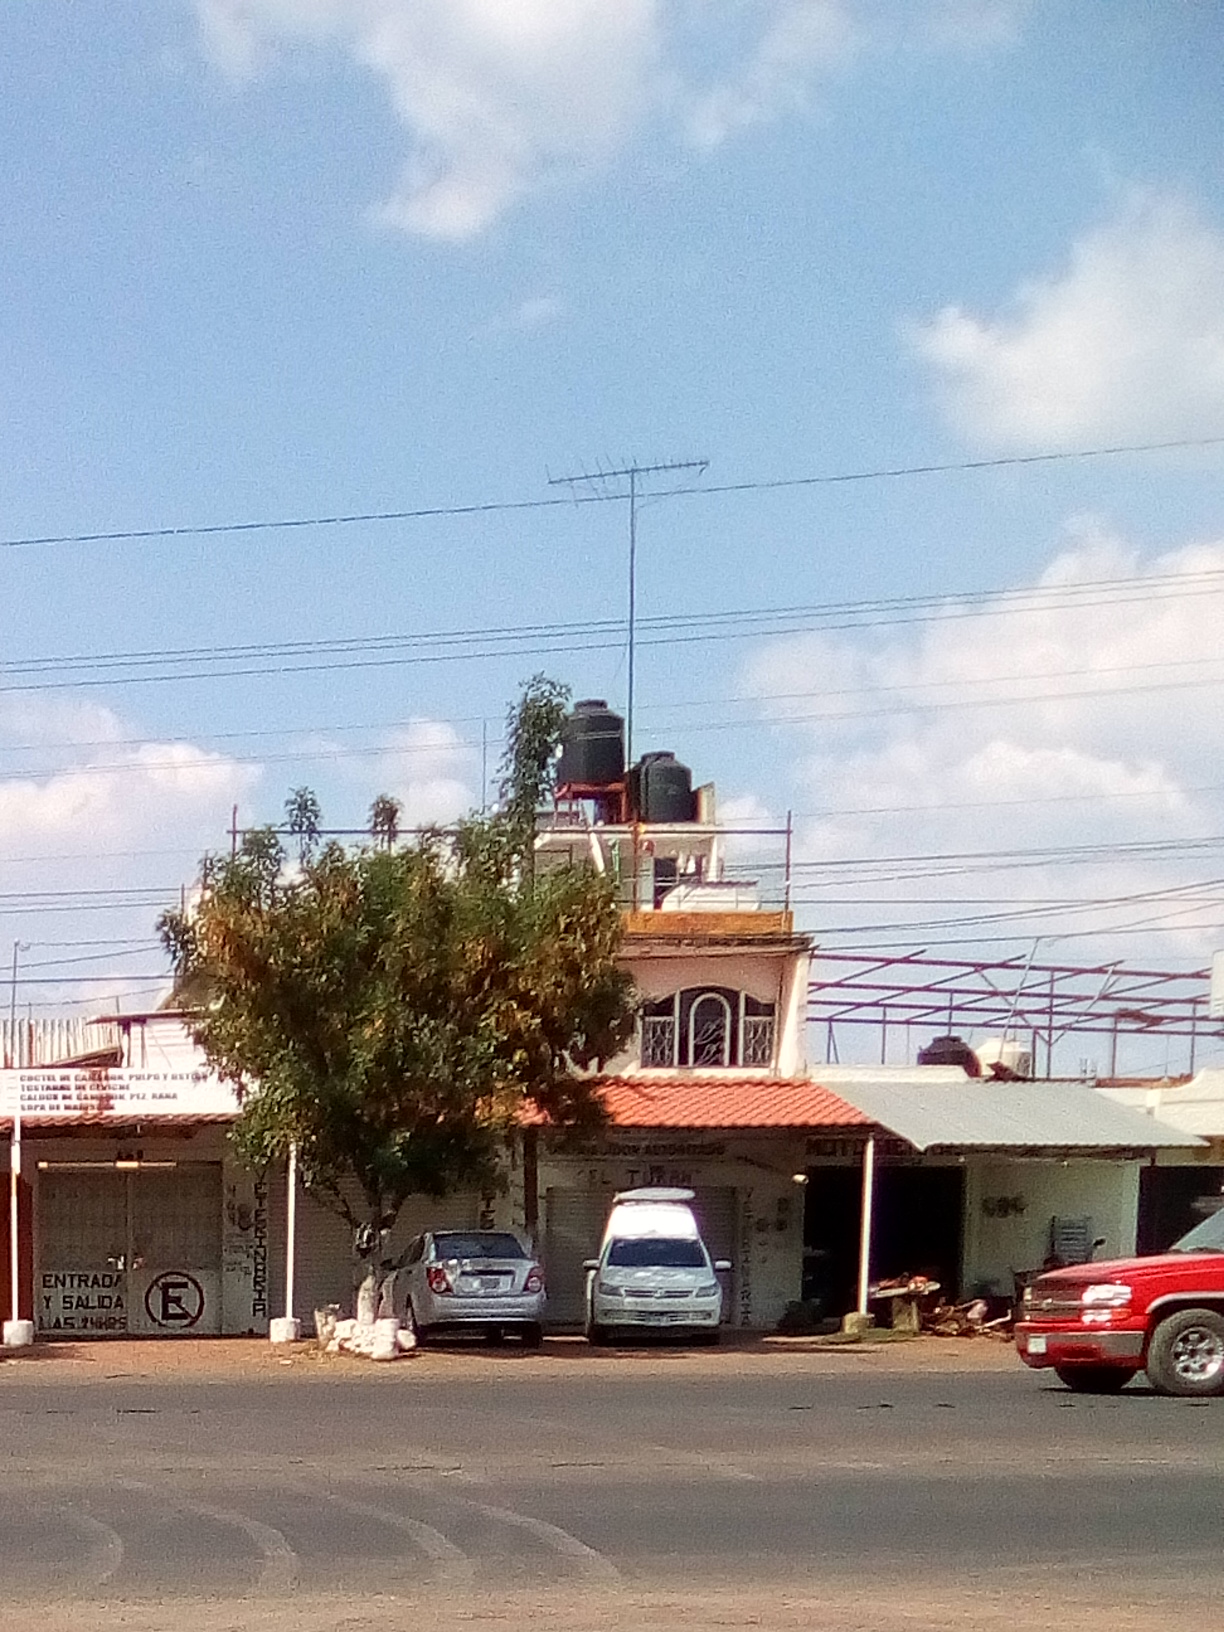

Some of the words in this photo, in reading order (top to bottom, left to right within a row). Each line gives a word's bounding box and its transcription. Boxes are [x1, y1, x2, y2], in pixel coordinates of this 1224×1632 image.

[20, 1074, 56, 1082] COCTEL
[129, 1073, 159, 1081] PULPO
[42, 1274, 122, 1288] ENTRADA
[43, 1295, 52, 1310] Y
[62, 1295, 124, 1310] SALIDA
